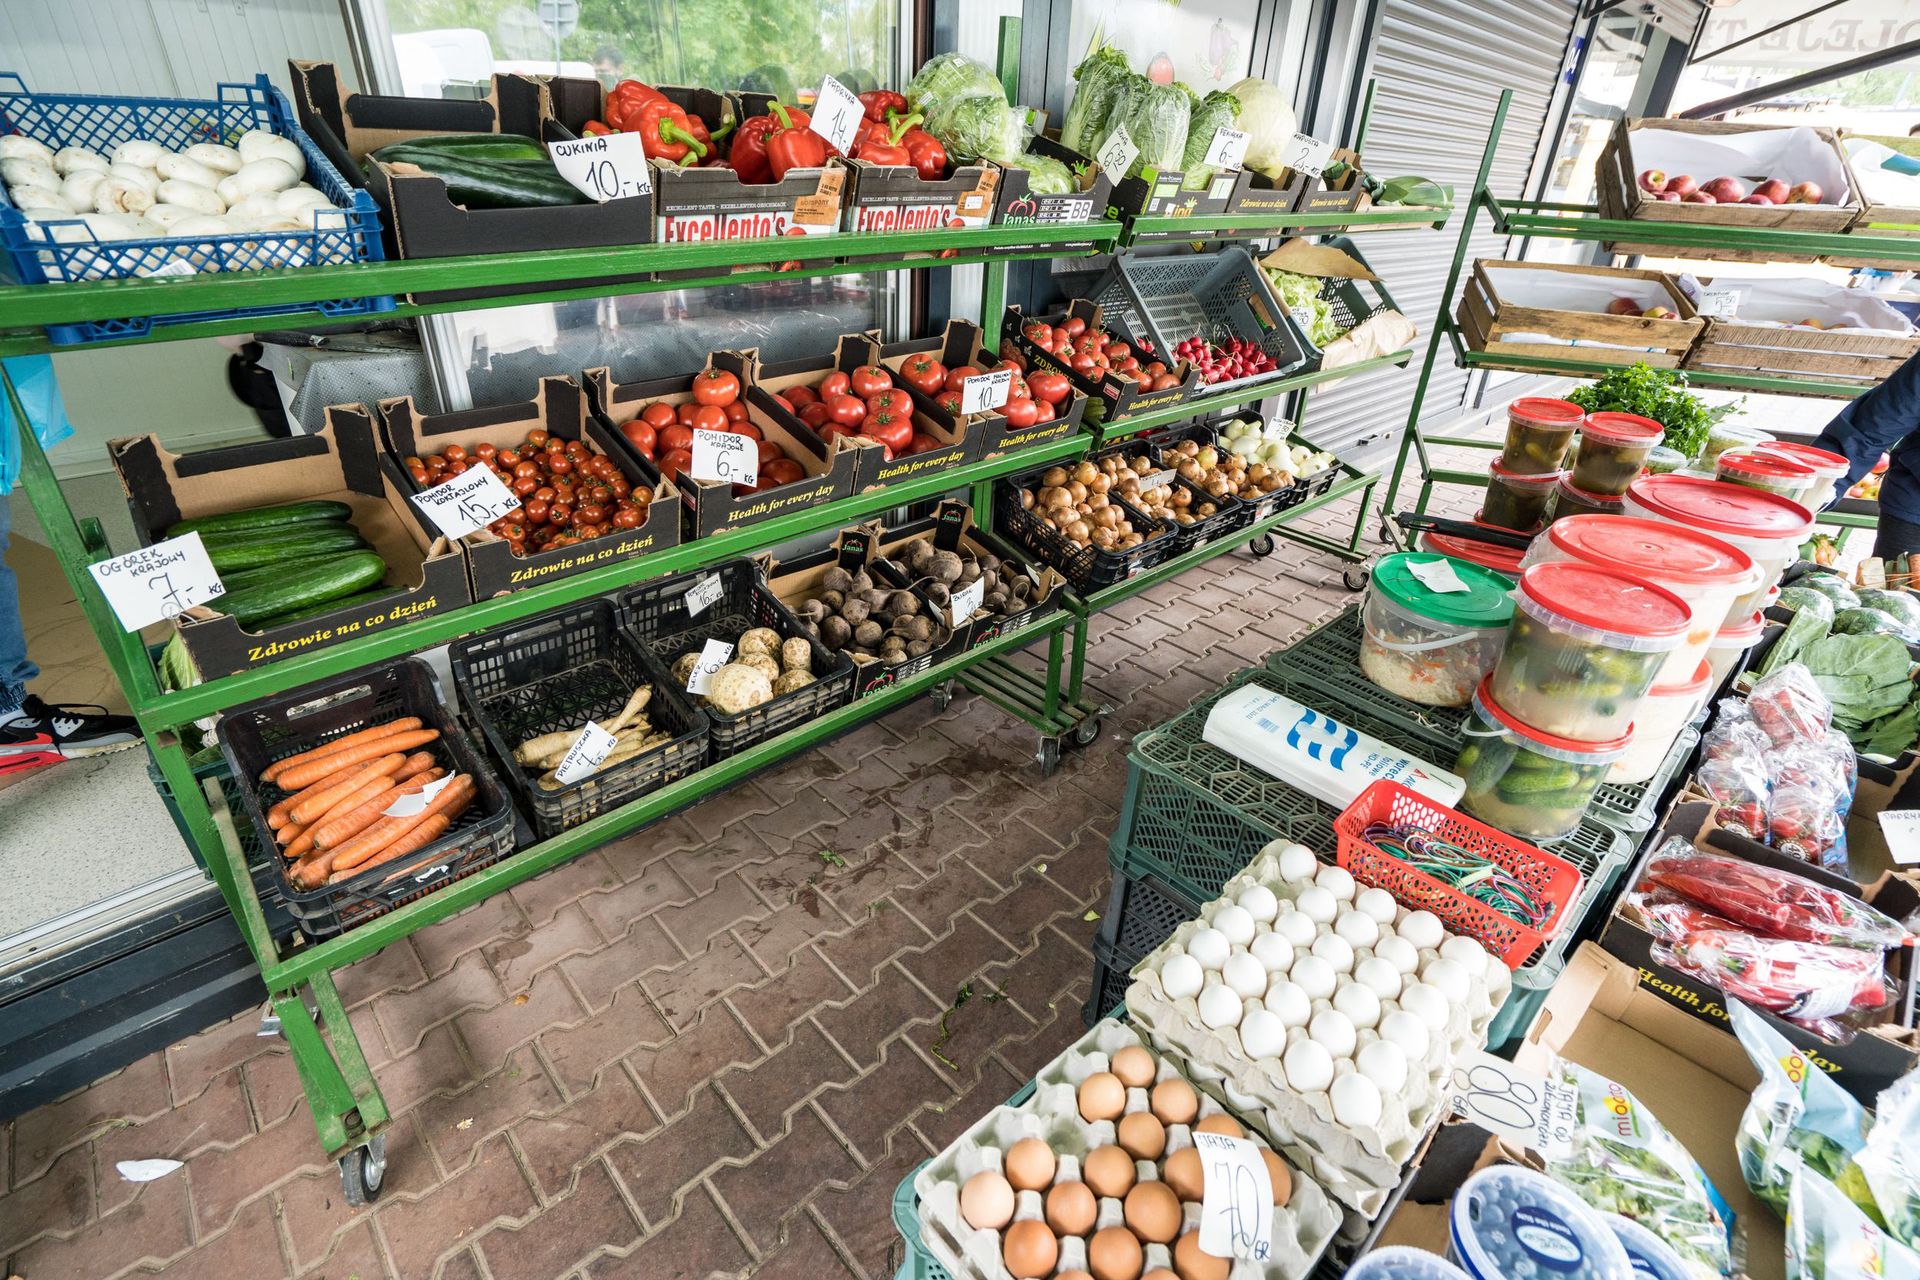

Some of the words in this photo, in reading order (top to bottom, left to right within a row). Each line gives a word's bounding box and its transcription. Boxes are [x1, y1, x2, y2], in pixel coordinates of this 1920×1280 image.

[556, 138, 608, 156] CUKINIA
[697, 430, 744, 445] POMIDOR
[998, 434, 1025, 449] Health
[1024, 430, 1037, 442] for
[1037, 427, 1055, 439] every
[1055, 423, 1070, 435] day
[878, 464, 910, 481] Health
[909, 461, 924, 474] for
[924, 456, 947, 470] every
[948, 451, 965, 463] day
[744, 473, 755, 485] KG
[415, 484, 455, 504] POMIDOR
[727, 502, 767, 523] Health
[766, 499, 784, 514] for
[787, 491, 814, 506] every
[815, 484, 835, 498] day
[510, 558, 574, 584] Zdrowie
[576, 553, 595, 565] na
[598, 549, 614, 560] co
[616, 534, 654, 555] dzień
[842, 544, 864, 553] Janas
[99, 548, 163, 577] OGÓREK
[208, 582, 223, 595] KG
[248, 630, 332, 662] Zdrowie
[336, 621, 361, 636] na
[364, 614, 385, 628] co
[389, 595, 438, 620] dzień
[1637, 966, 1700, 1007] Health
[1198, 1134, 1237, 1151] JAJA
[1254, 1240, 1271, 1261] GR
